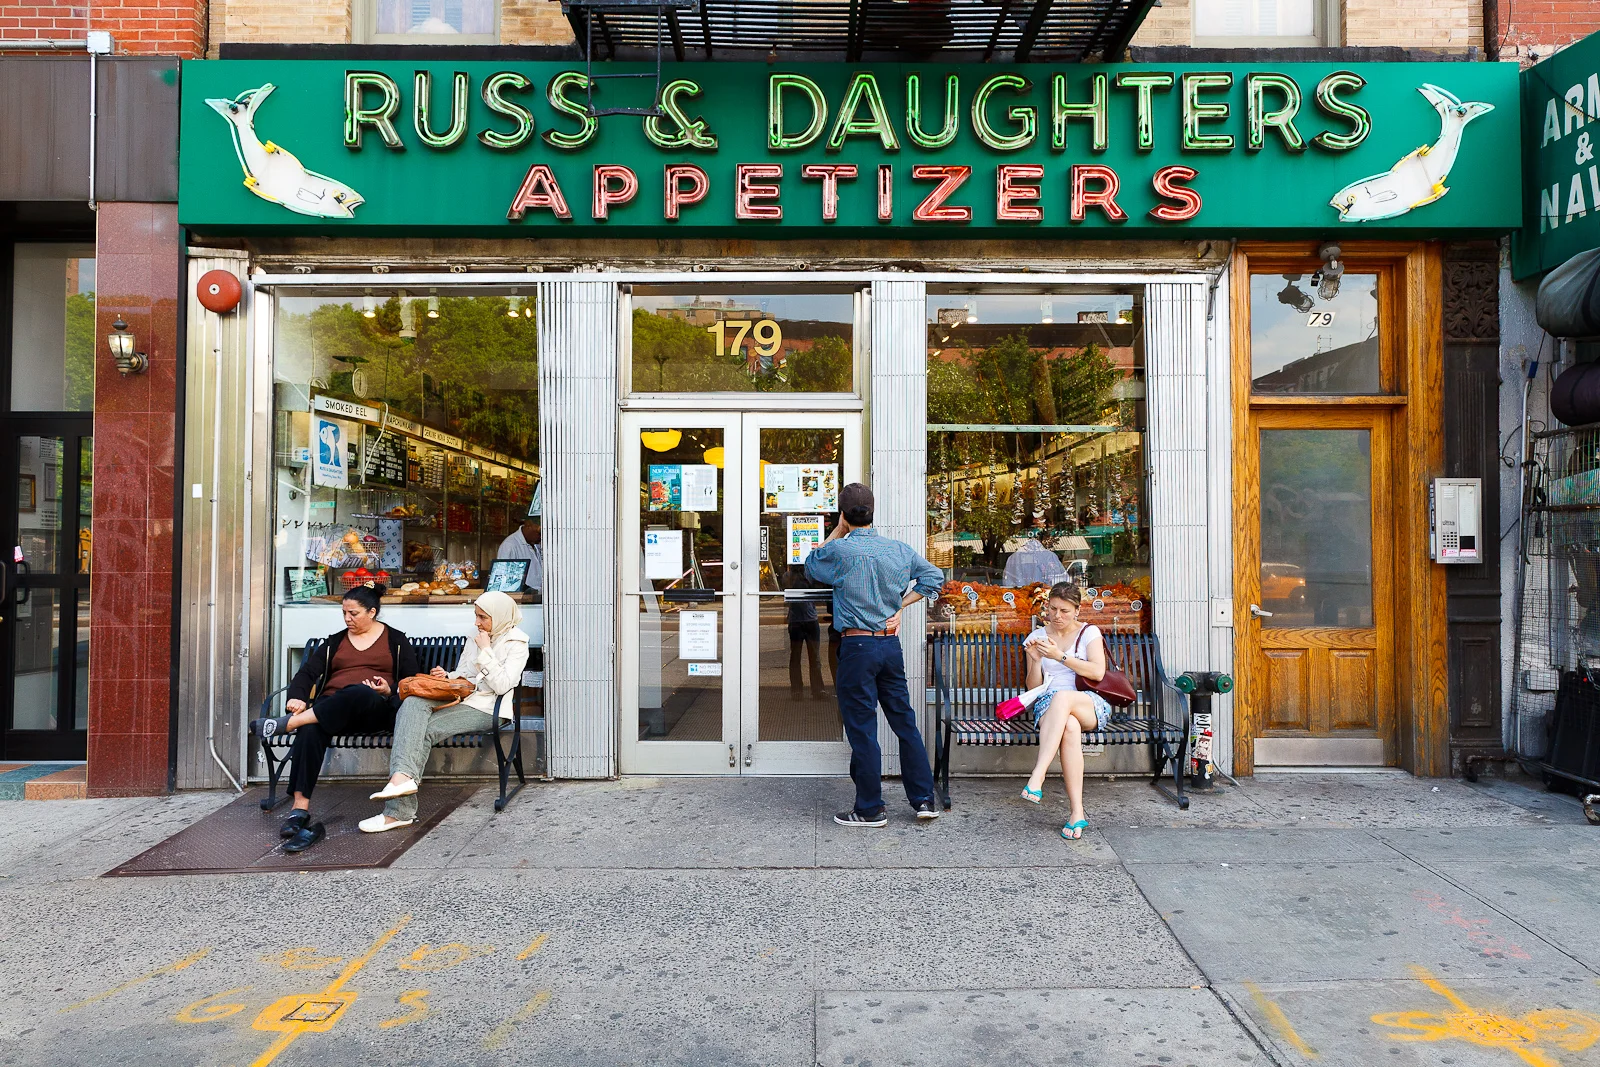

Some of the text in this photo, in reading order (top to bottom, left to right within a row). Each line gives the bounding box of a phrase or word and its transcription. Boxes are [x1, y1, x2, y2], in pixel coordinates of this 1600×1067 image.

[343, 69, 1373, 152] RUSS & DAUGHTERS
[1575, 131, 1594, 166] &
[506, 162, 1203, 222] APPETIZERS
[1309, 312, 1332, 326] 79
[707, 319, 783, 357] 179
[325, 399, 368, 417] SMOKED EEL
